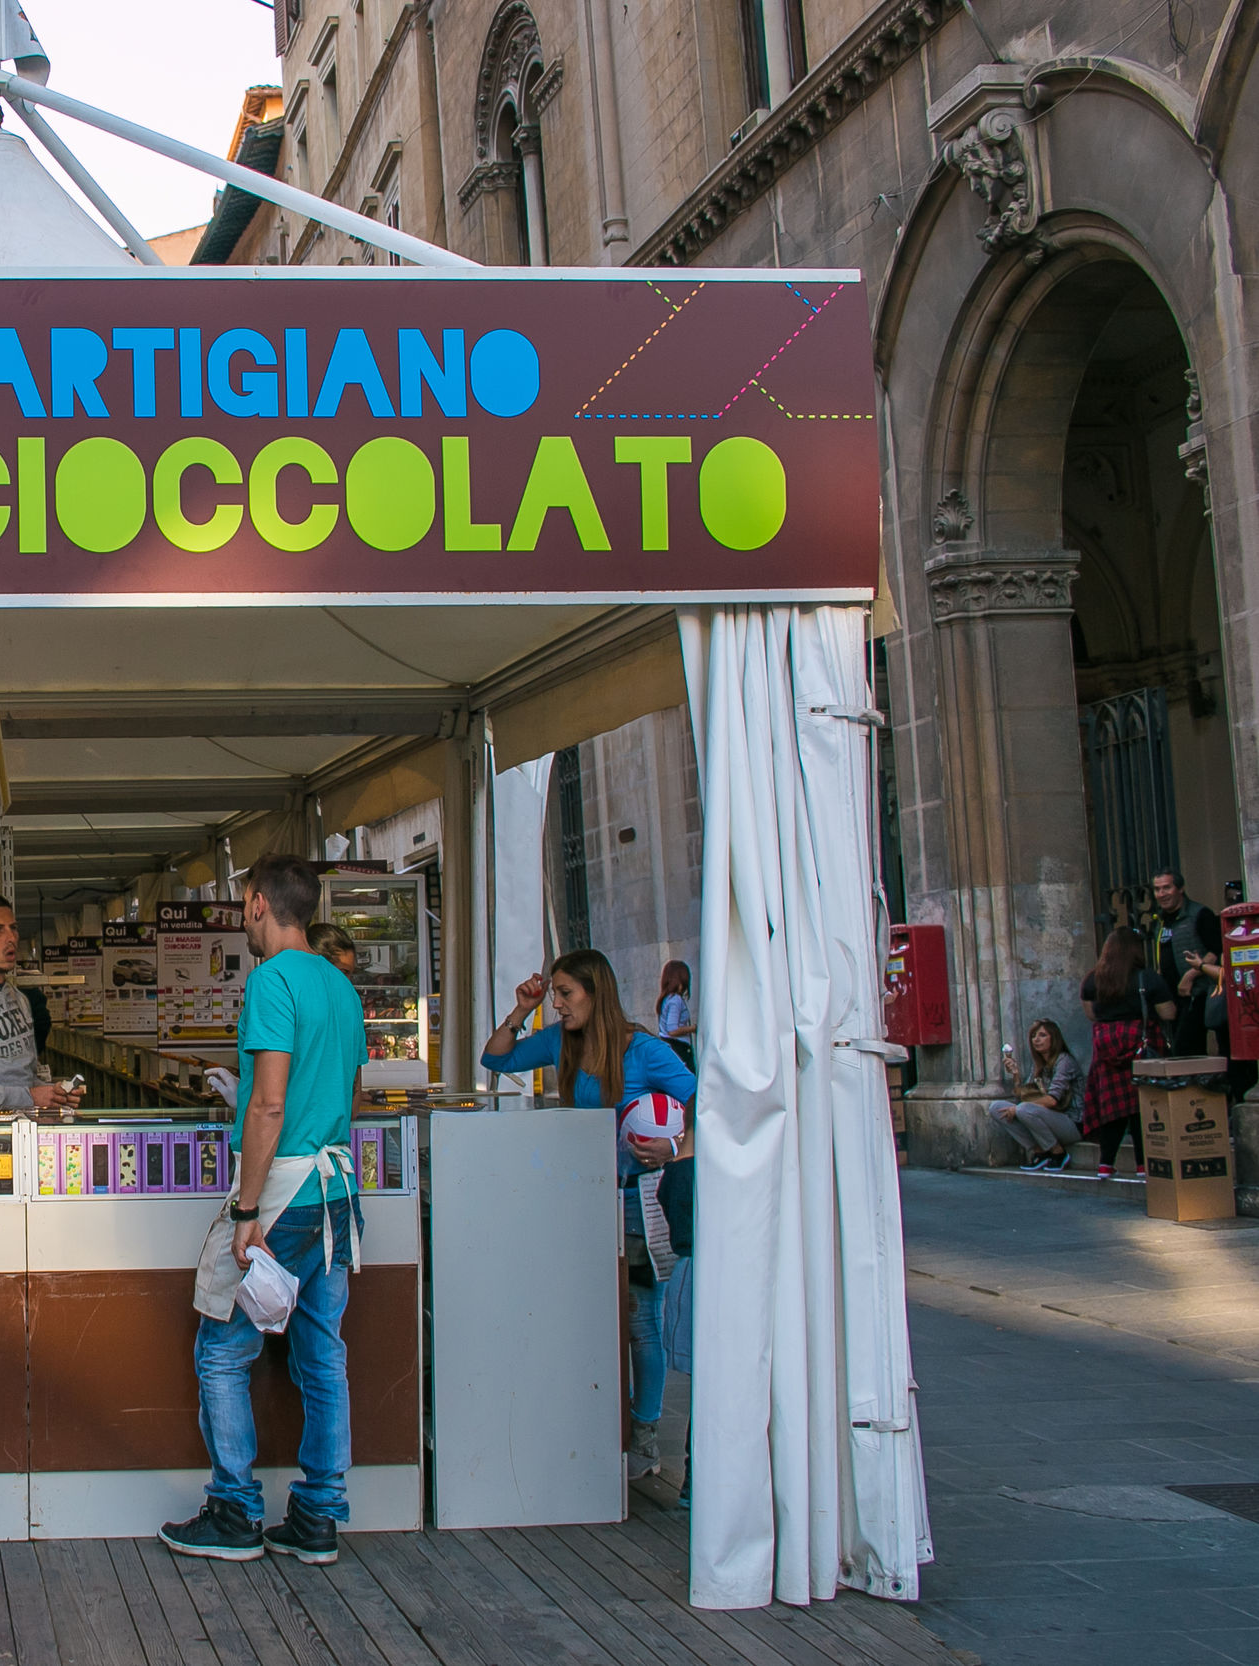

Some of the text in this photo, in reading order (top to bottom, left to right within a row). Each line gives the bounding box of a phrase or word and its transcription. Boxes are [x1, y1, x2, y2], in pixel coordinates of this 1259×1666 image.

[160, 906, 187, 920] Qui
[171, 921, 203, 929] vendita
[105, 926, 127, 937] Qui
[69, 939, 87, 949] Qui
